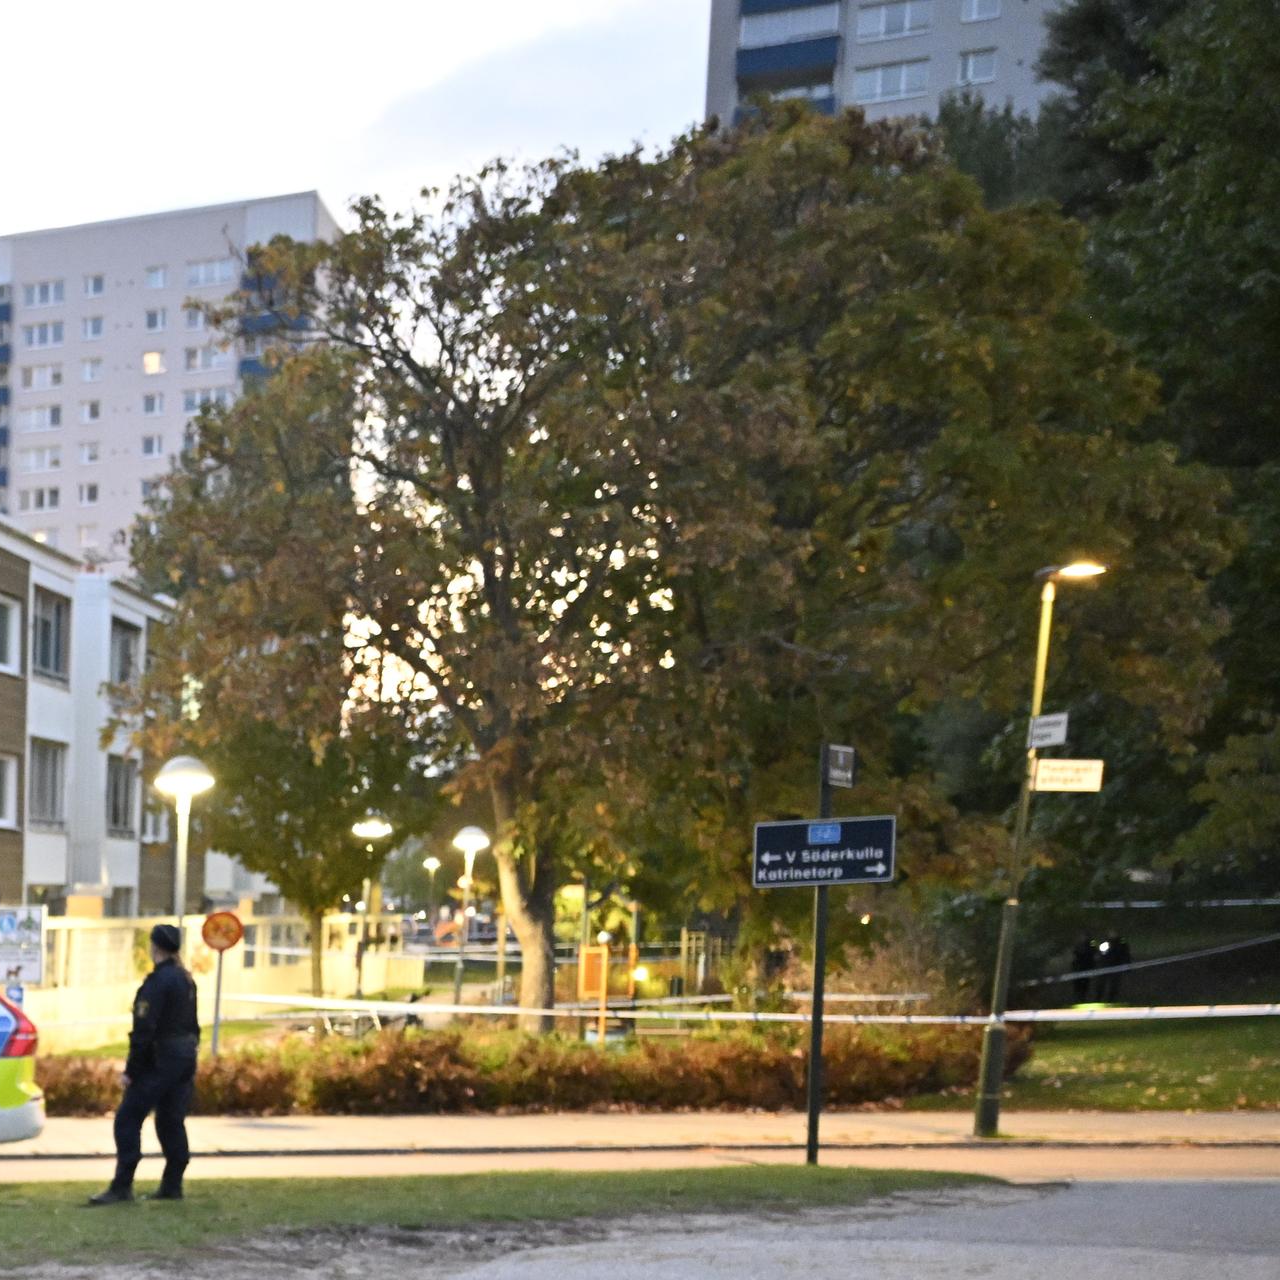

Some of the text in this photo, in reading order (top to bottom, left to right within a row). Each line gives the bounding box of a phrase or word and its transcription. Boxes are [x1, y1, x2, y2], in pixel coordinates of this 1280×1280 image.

[785, 847, 884, 864] V Söderkulla
[757, 867, 843, 881] Katrinetorp
